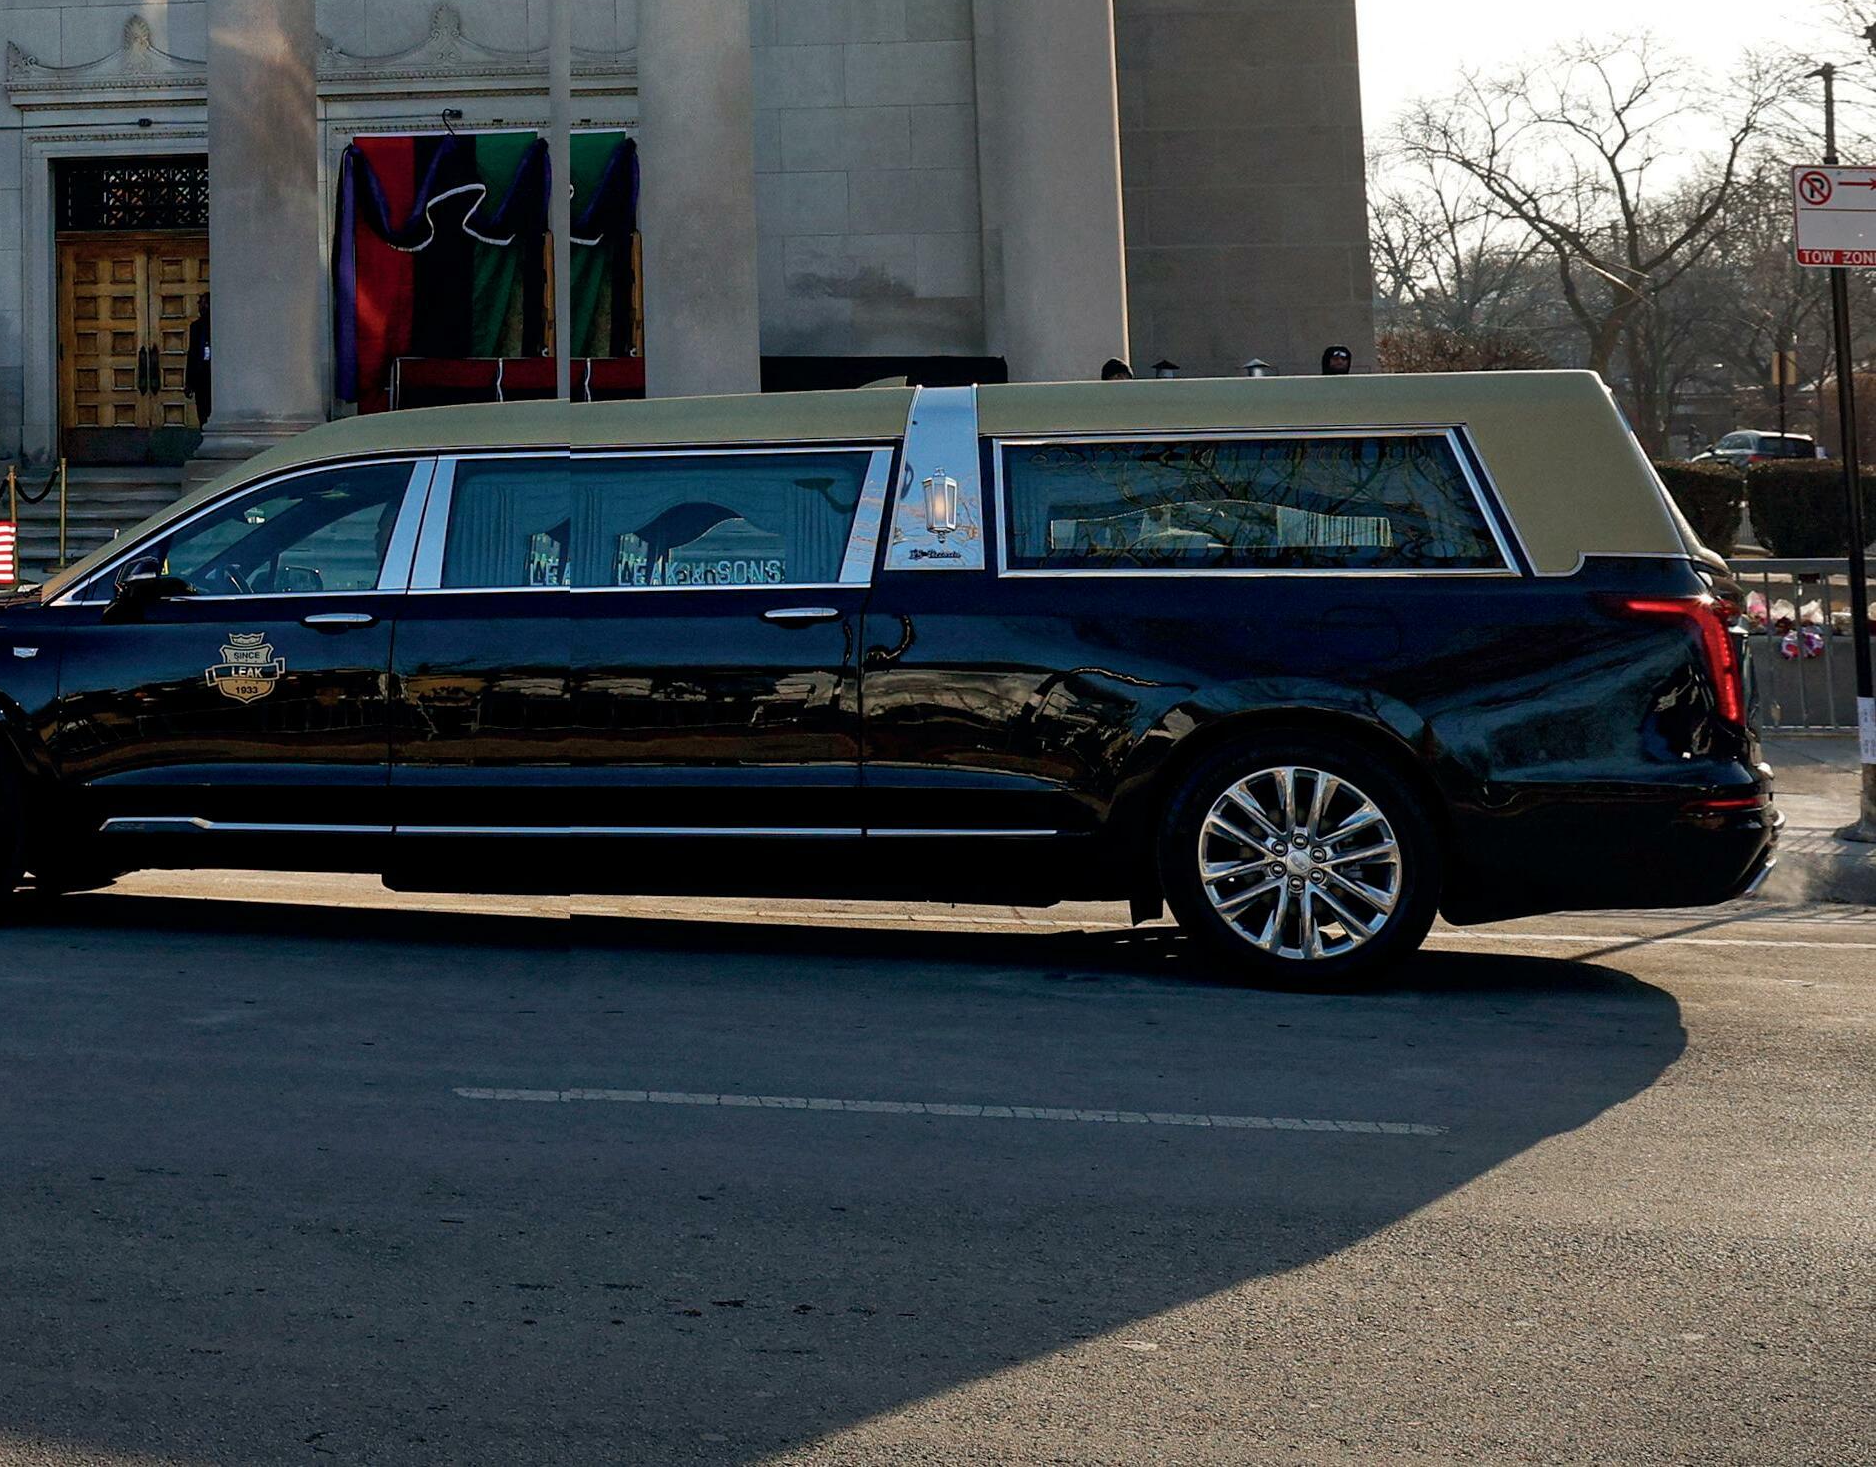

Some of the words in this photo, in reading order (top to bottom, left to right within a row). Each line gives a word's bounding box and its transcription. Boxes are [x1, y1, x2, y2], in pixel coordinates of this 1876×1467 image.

[1802, 250, 1834, 264] TOW
[1842, 251, 1876, 265] ZON
[617, 560, 678, 586] LEAK
[718, 558, 781, 584] SONS
[234, 652, 260, 660] SINCE
[231, 666, 263, 678] LEAK
[235, 687, 258, 695] 1933
